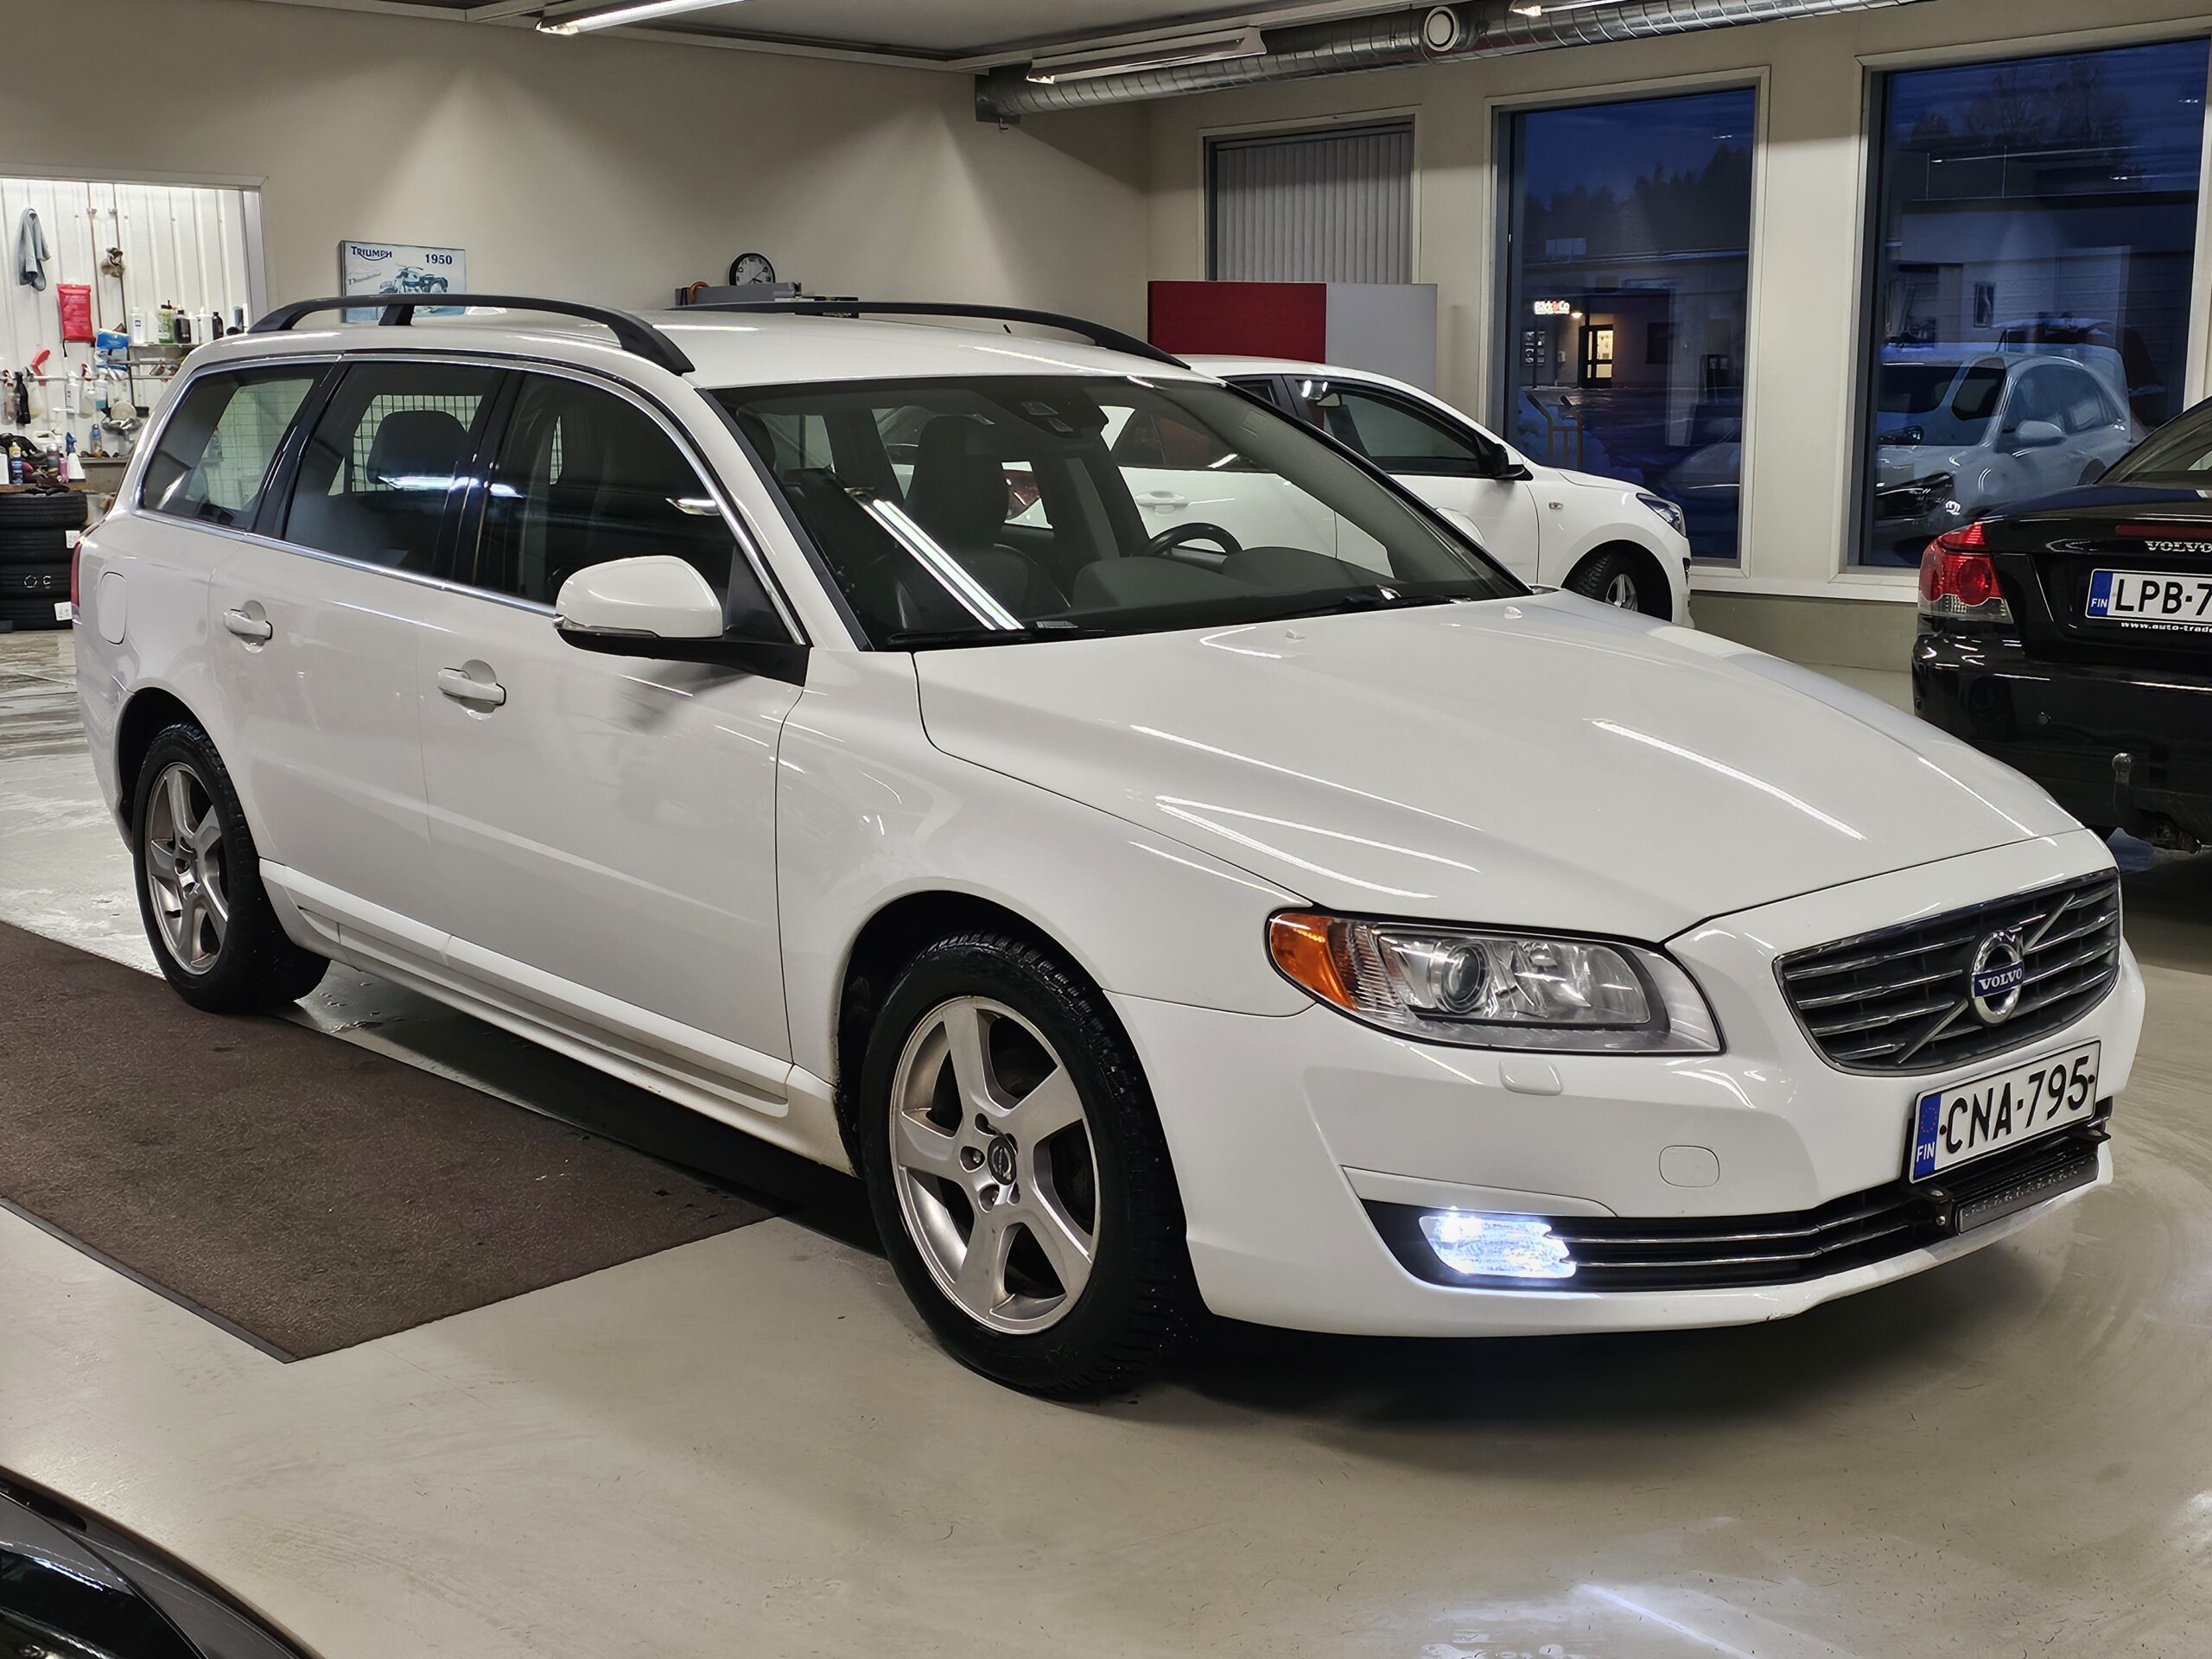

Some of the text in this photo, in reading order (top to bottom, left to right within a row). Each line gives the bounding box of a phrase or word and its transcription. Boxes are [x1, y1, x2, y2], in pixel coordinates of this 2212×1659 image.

[351, 246, 392, 261] TRIUMPH
[425, 254, 453, 264] 1950
[2145, 540, 2212, 553] VOLVO
[2091, 598, 2107, 607] FIN
[1979, 968, 2022, 989] VOLVO
[1946, 1055, 2089, 1154] CNA-795
[1916, 1141, 1936, 1162] FIN
